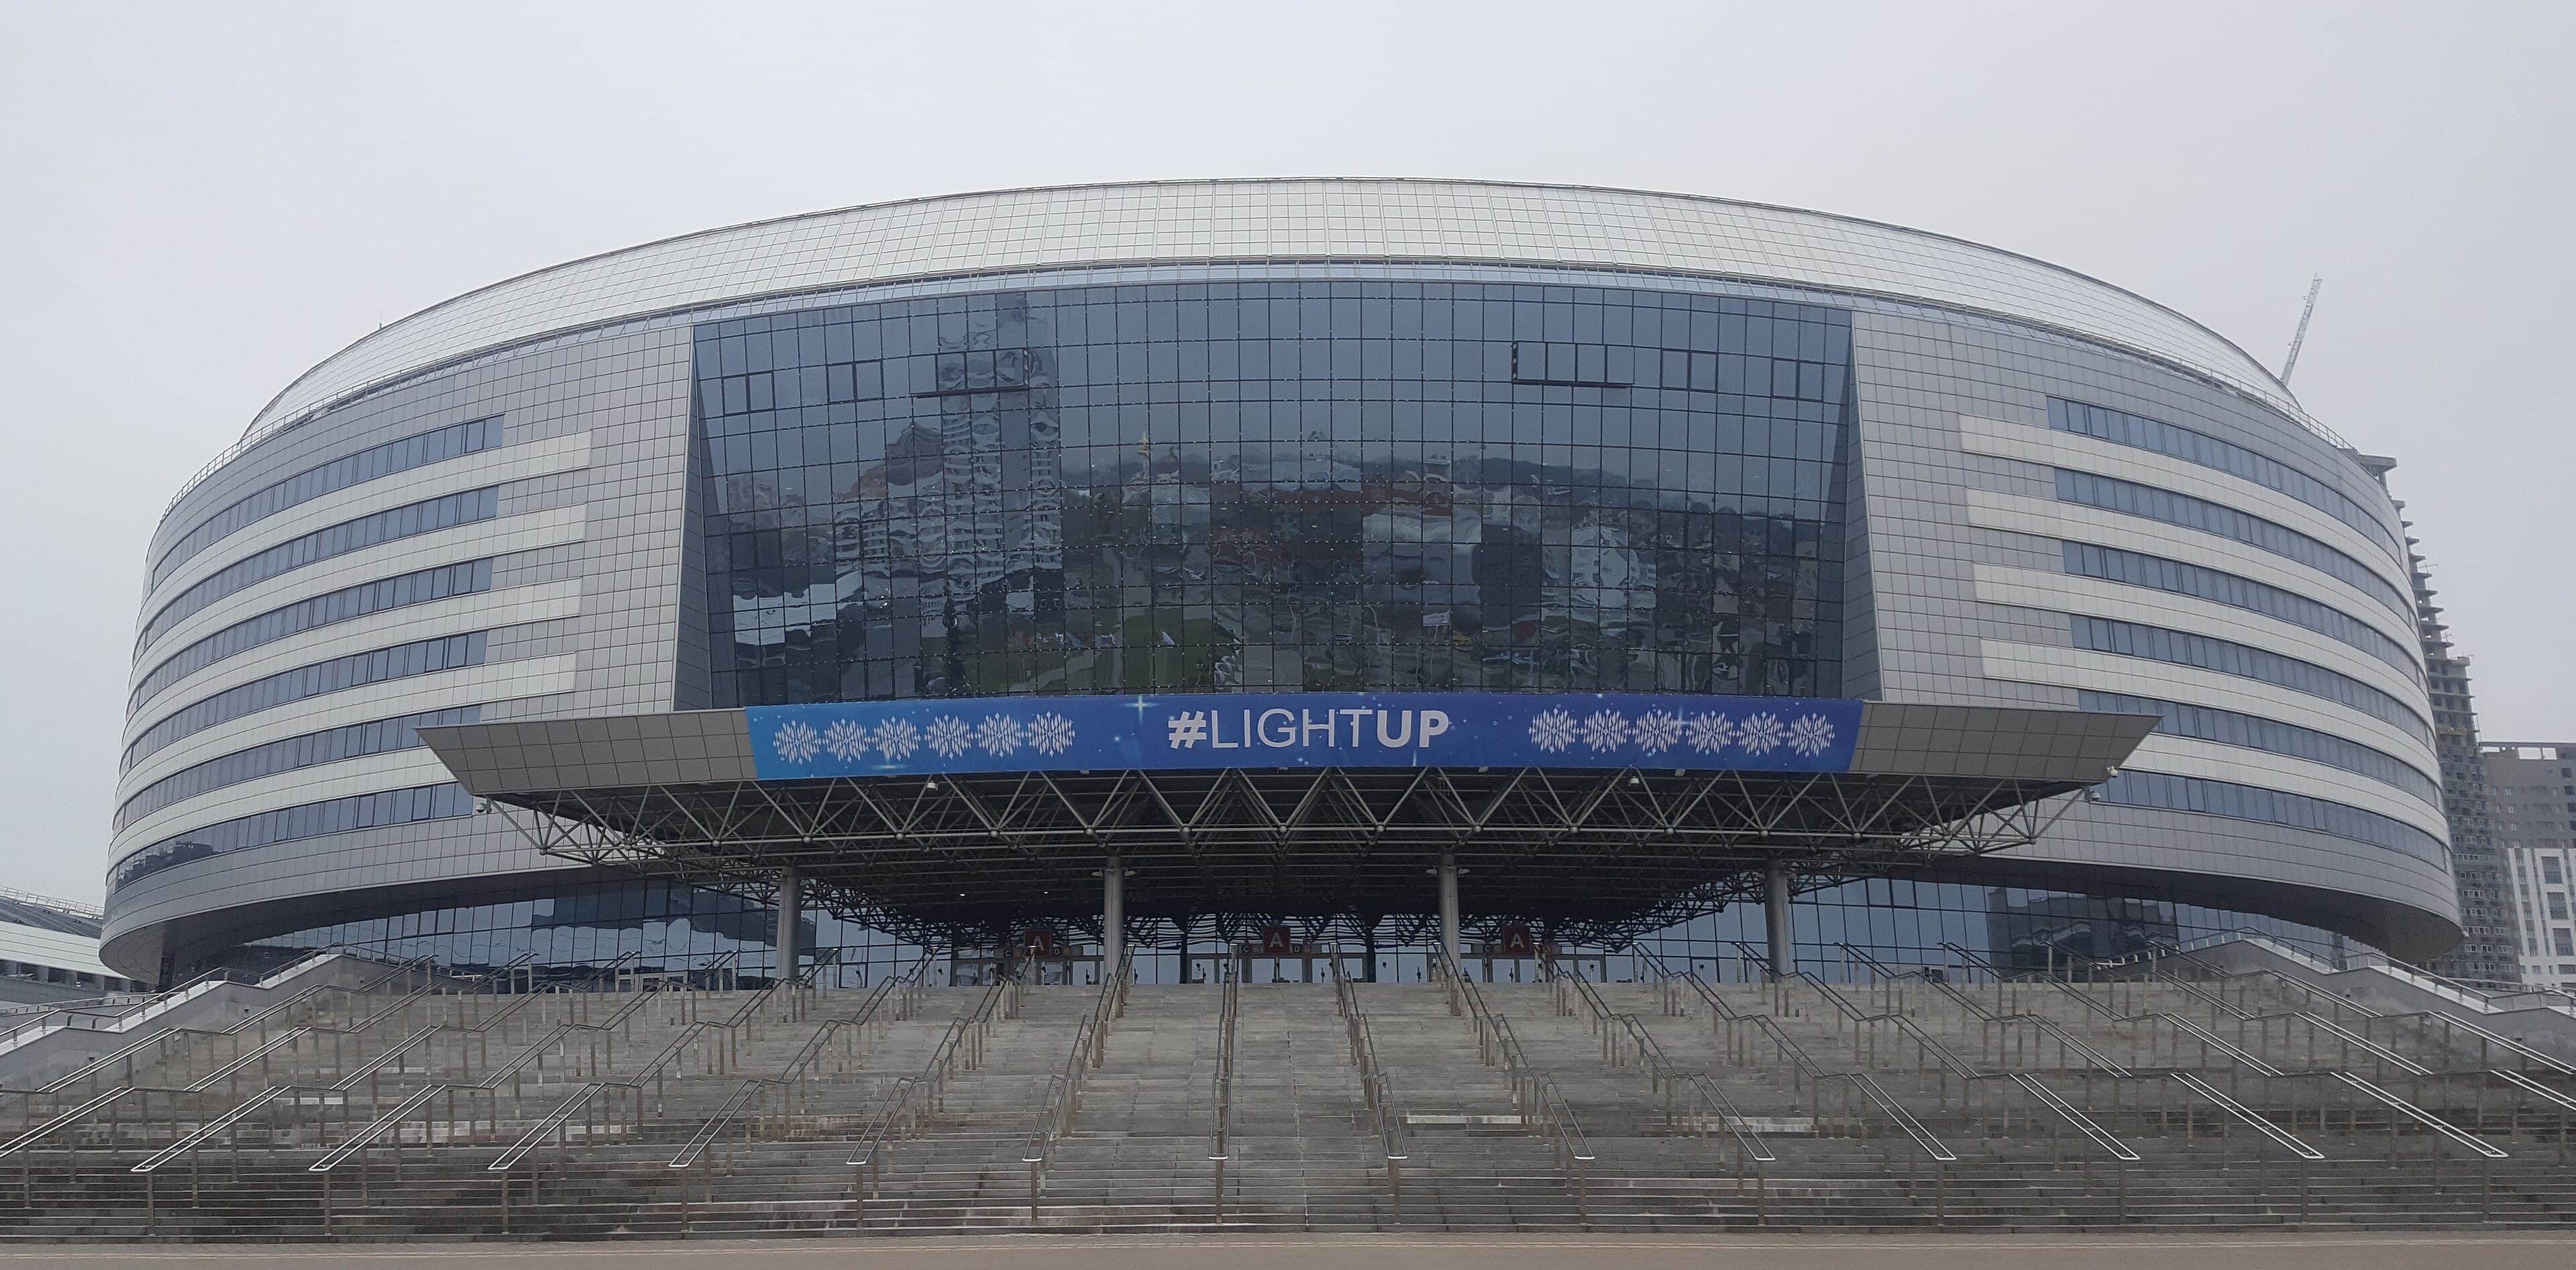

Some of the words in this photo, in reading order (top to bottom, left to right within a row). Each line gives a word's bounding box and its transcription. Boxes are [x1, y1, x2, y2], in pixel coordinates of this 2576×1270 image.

[1168, 708, 1450, 749] #LIGHTUP
[1031, 936, 1045, 951] A
[1269, 932, 1283, 947] A
[1510, 933, 1524, 948] A
